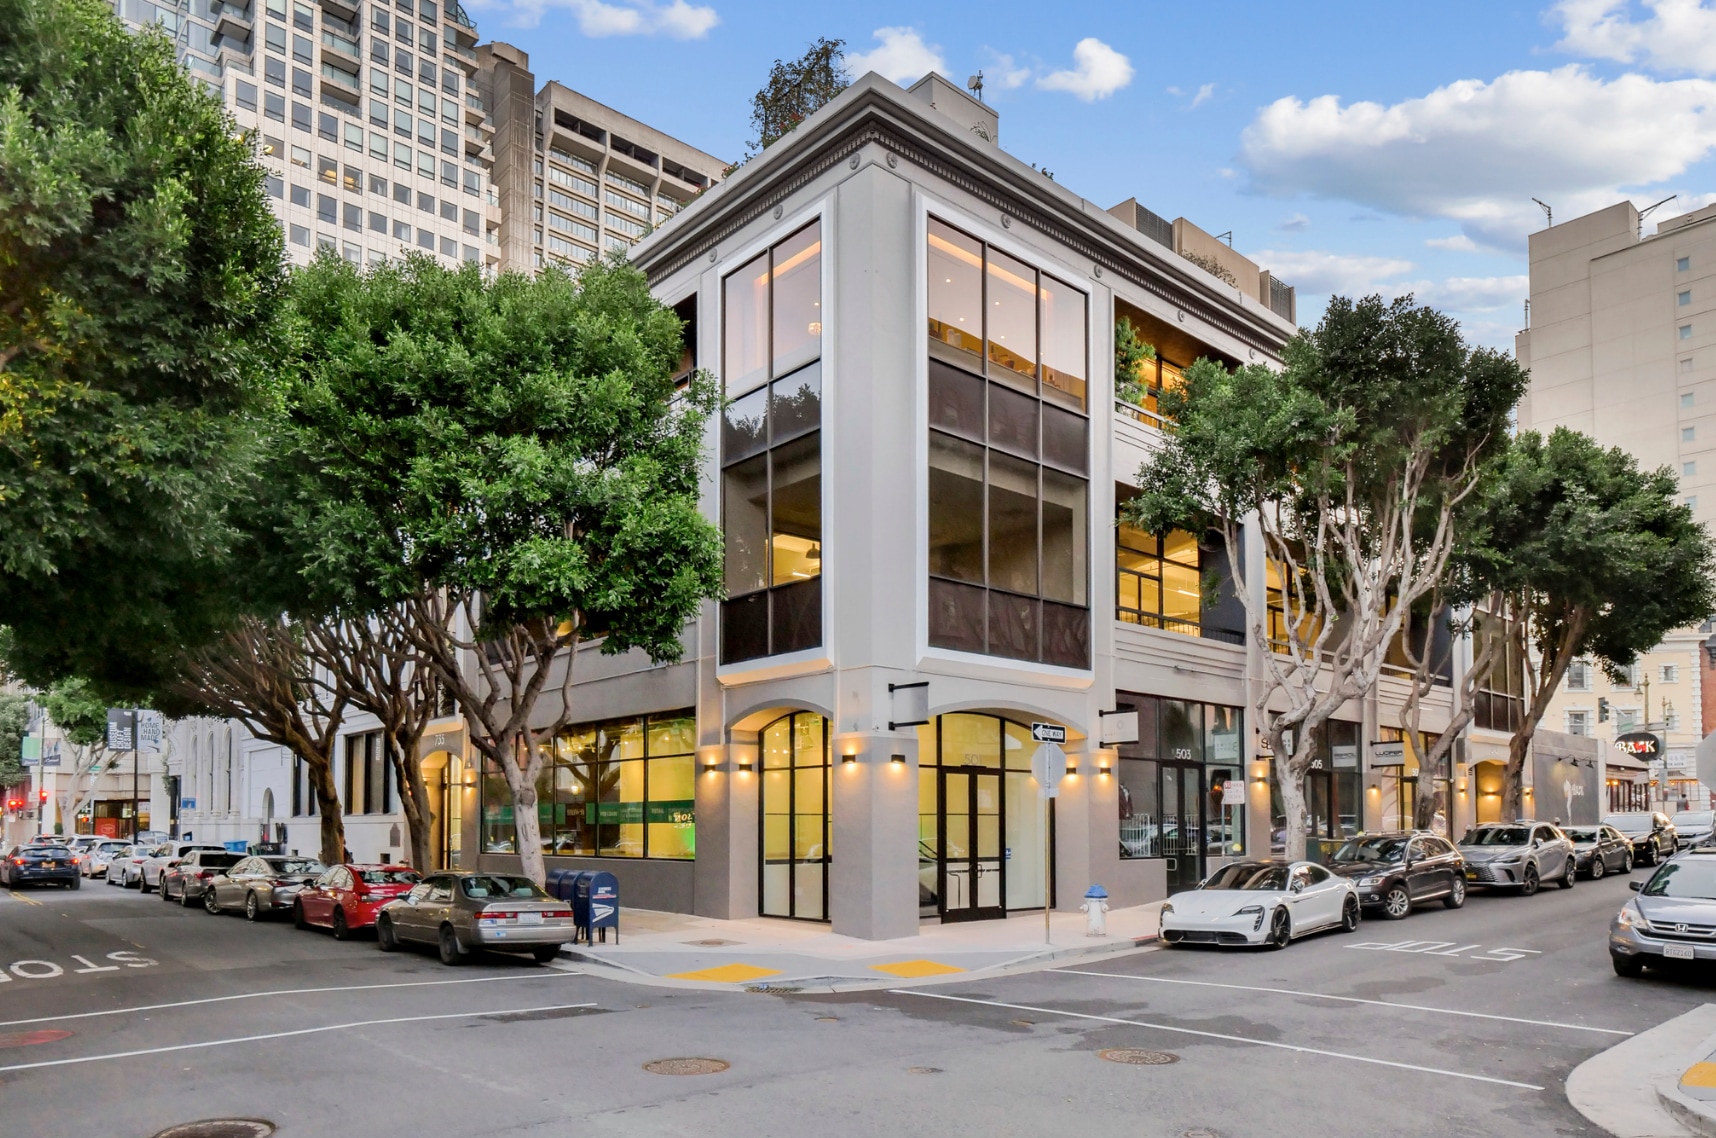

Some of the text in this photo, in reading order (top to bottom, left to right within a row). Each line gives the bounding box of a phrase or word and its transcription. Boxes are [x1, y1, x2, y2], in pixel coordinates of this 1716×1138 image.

[140, 722, 160, 730] HOME
[109, 722, 117, 750] MUSEUM
[123, 727, 132, 750] DESIGN
[143, 728, 161, 737] HAND
[1041, 729, 1063, 738] ONE WAY
[434, 733, 445, 746] 735
[1175, 748, 1192, 760] 503
[1411, 767, 1420, 777] 50
[1343, 940, 1542, 962] STOP
[0, 951, 160, 983] STO
